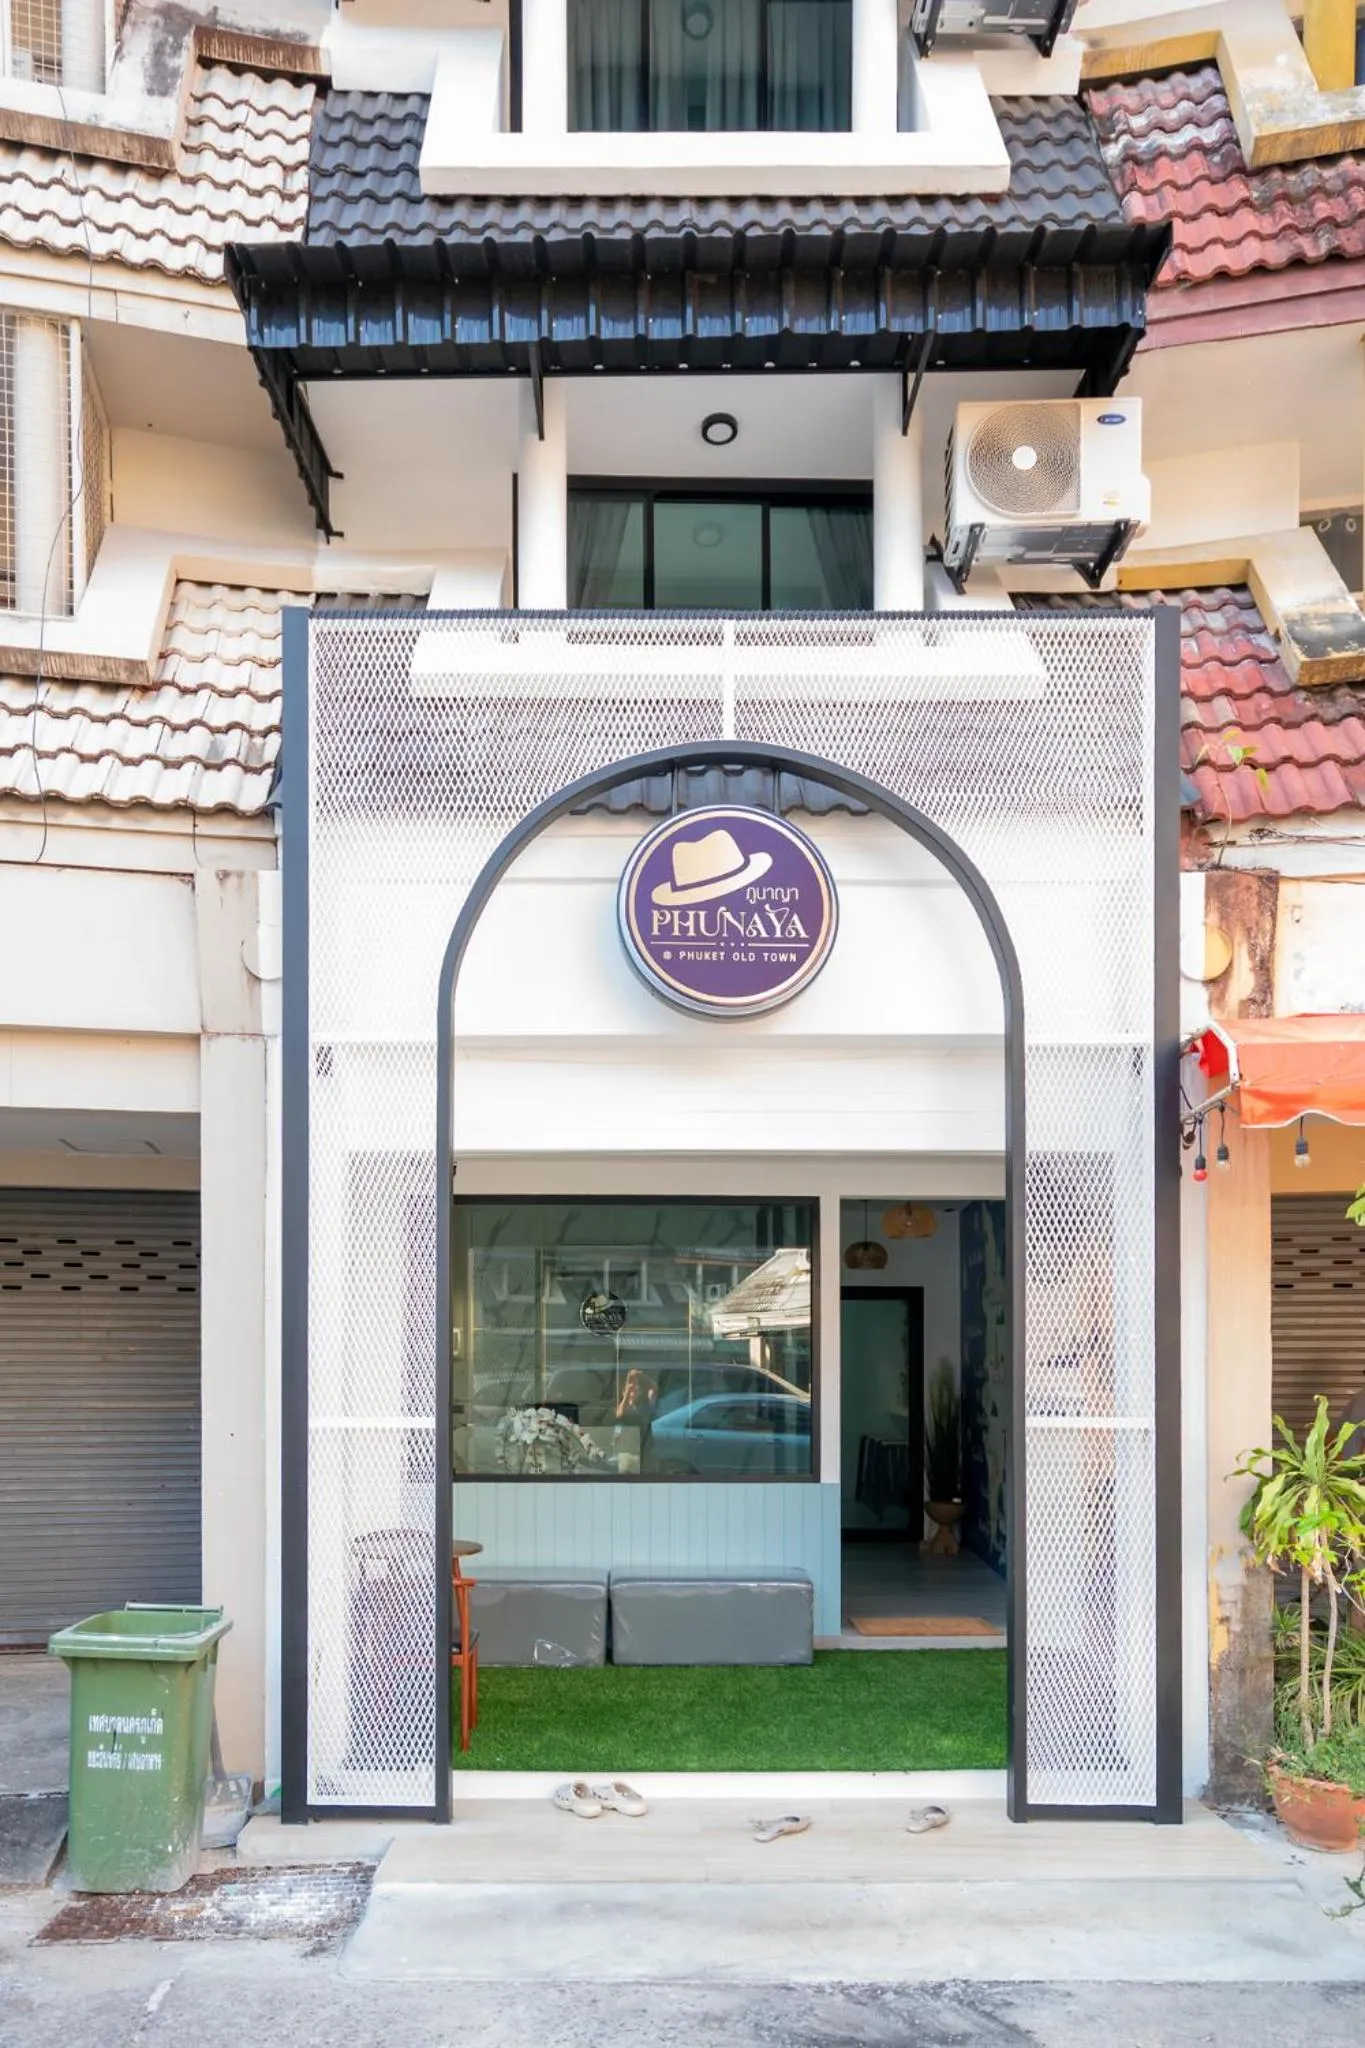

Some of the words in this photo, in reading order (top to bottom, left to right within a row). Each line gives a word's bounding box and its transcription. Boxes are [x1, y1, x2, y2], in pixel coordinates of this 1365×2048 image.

[746, 886, 799, 904] ภูนาญา
[651, 905, 809, 938] PHUNAYA
[679, 951, 725, 961] PHUKET
[732, 952, 756, 962] OLD
[763, 952, 797, 962] TOWN
